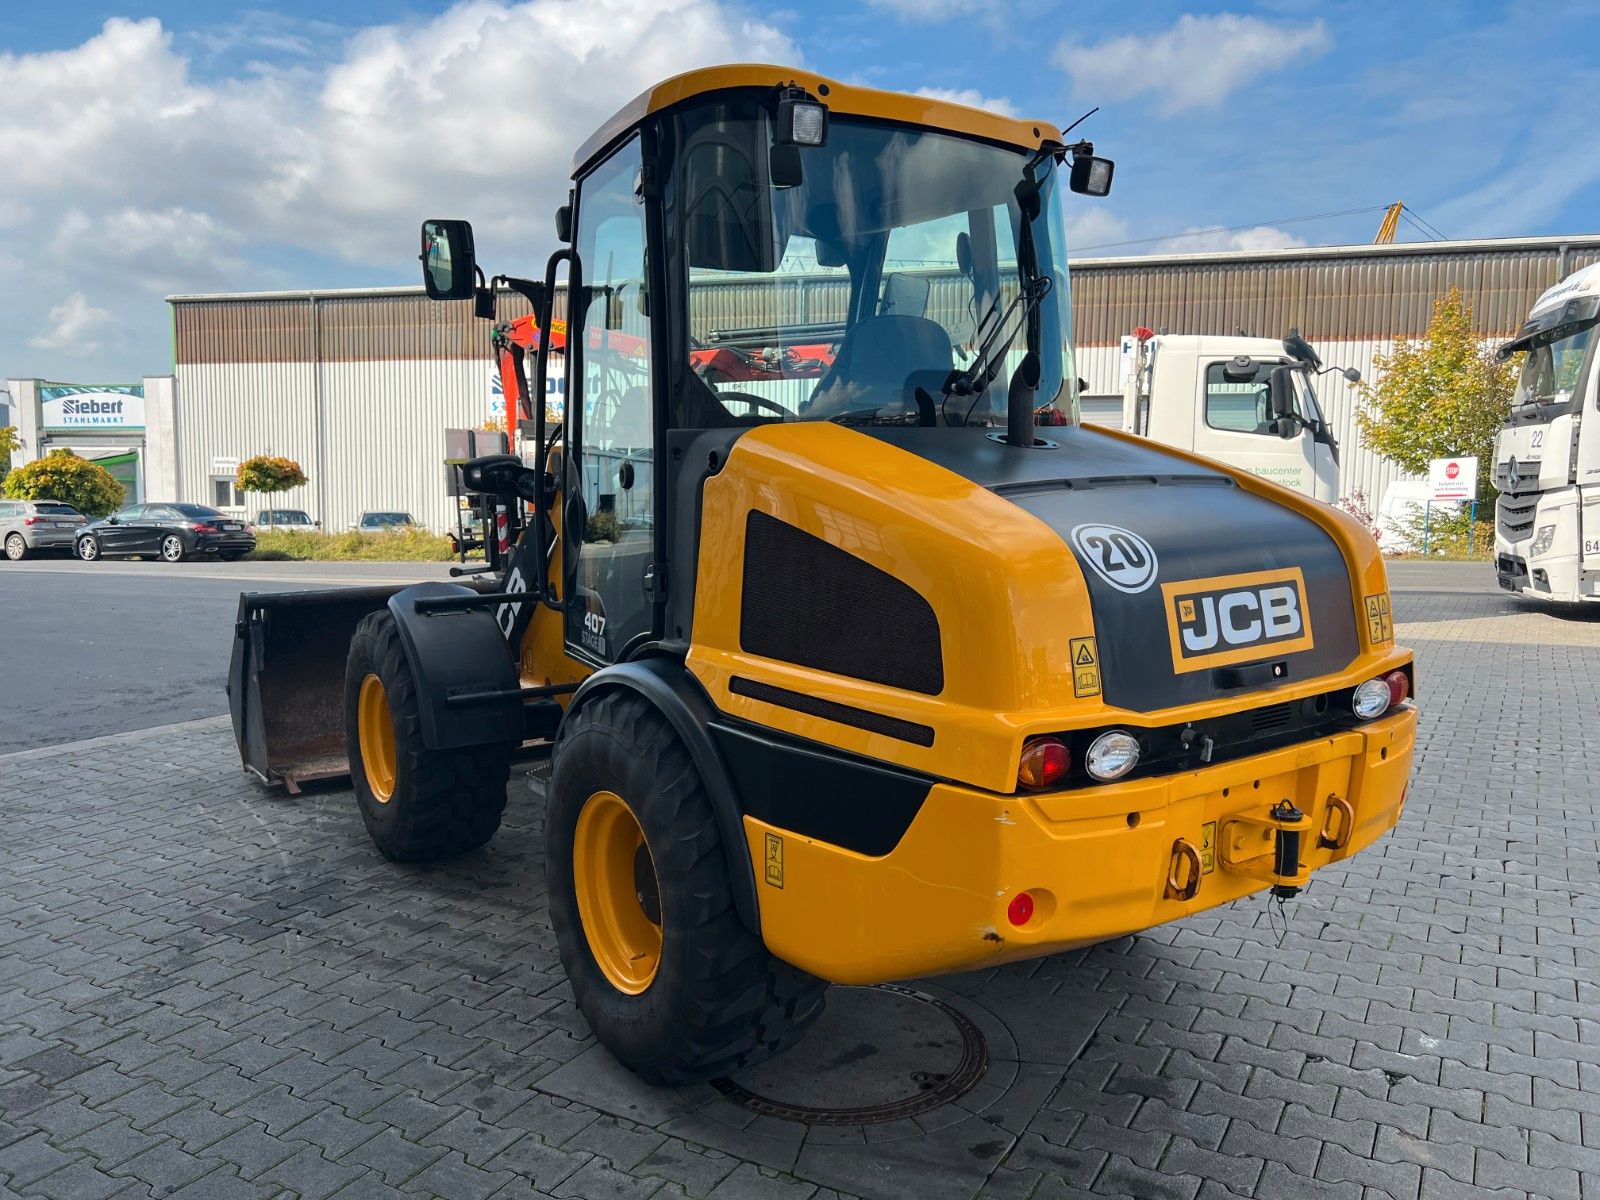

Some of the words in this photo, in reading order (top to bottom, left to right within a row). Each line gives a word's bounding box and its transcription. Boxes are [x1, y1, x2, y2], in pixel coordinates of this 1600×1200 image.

[63, 399, 123, 414] Siebert
[63, 416, 124, 424] STAHLMARKT
[1531, 430, 1543, 448] 22
[1255, 466, 1302, 475] baucenter
[1086, 533, 1146, 572] 20
[584, 611, 606, 636] 407
[1182, 585, 1301, 651] JCB
[581, 630, 599, 650] STAGE
